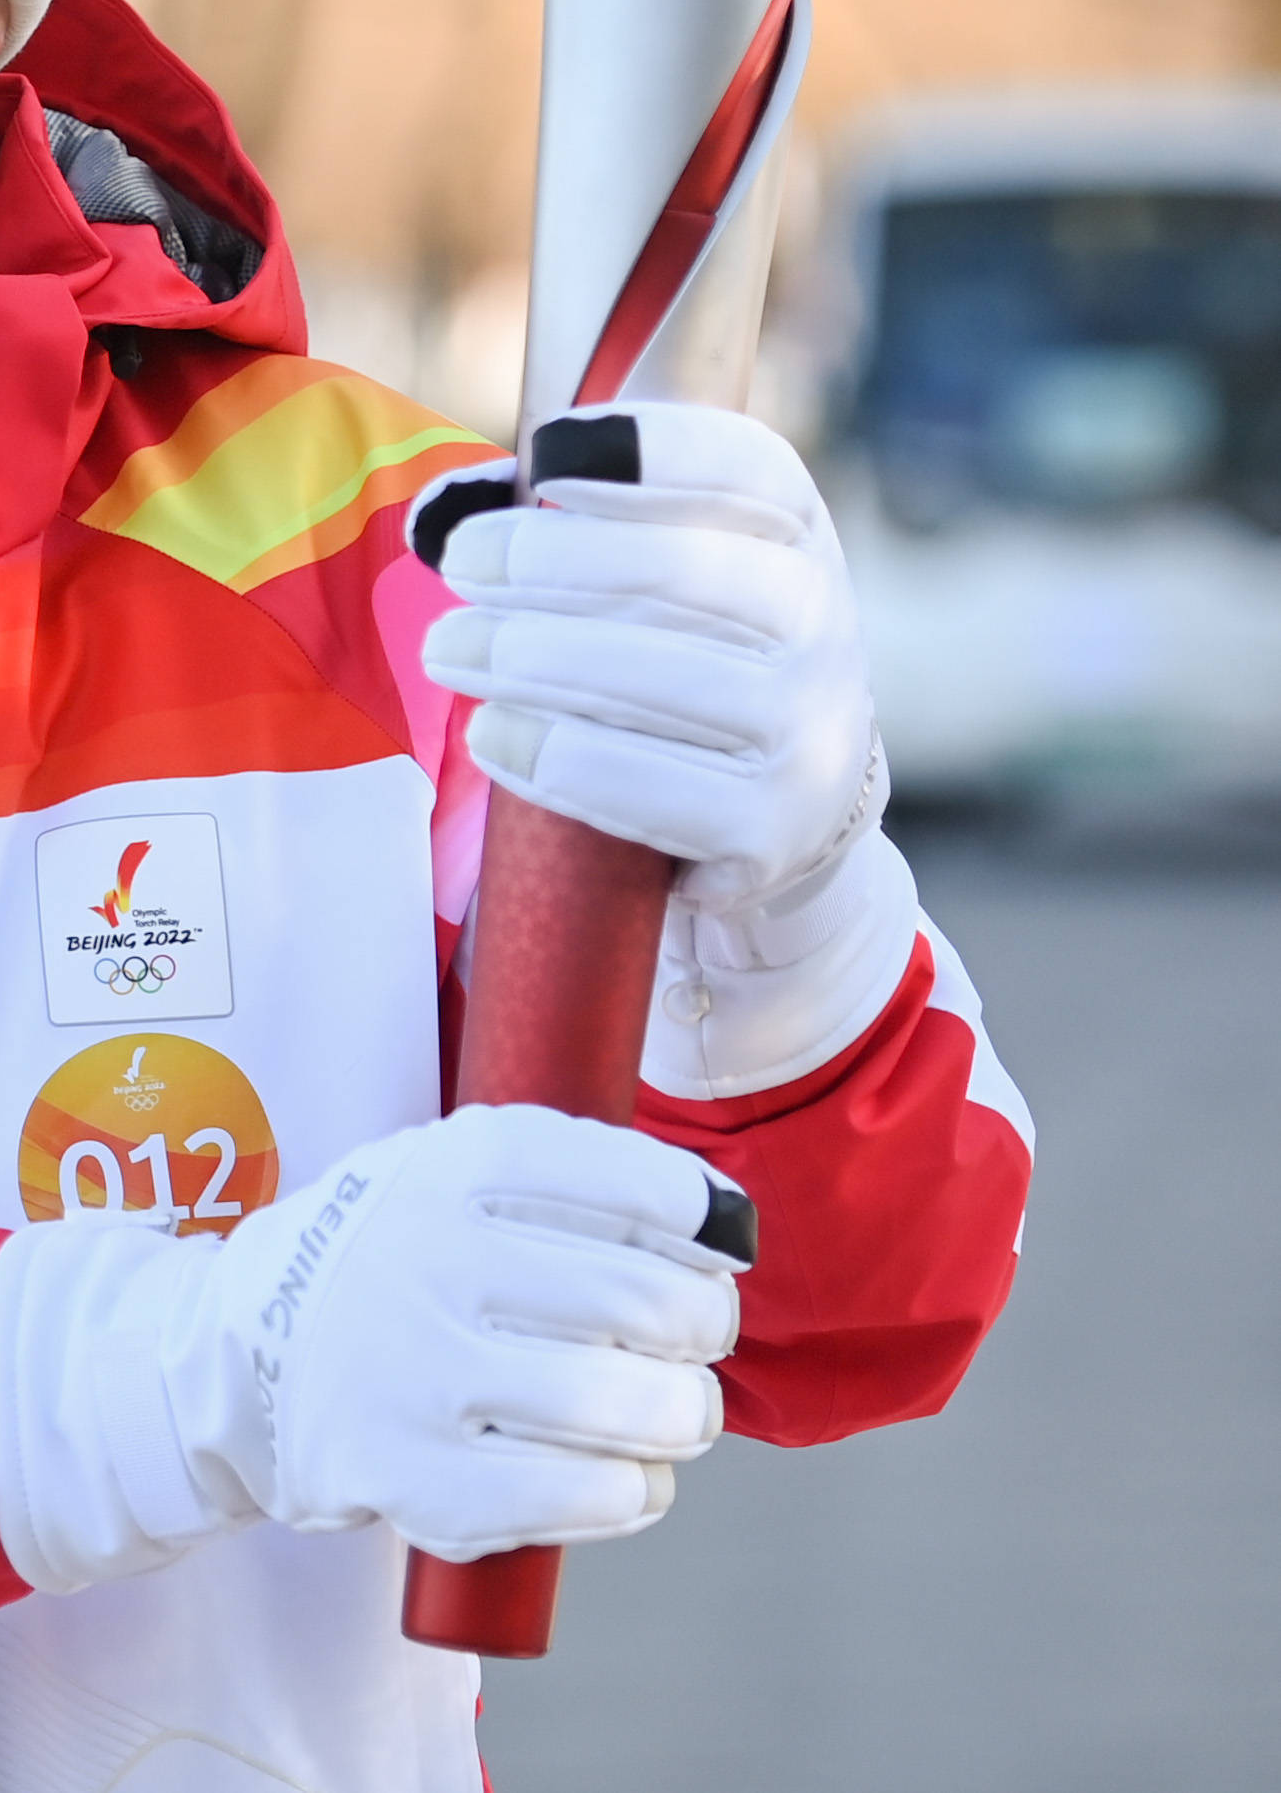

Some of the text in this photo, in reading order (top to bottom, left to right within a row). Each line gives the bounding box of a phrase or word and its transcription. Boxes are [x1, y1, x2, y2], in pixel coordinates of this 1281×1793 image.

[132, 907, 167, 919] Olympic
[134, 918, 180, 927] Torch Relay
[66, 932, 136, 955] BEIJING
[143, 929, 196, 946] 2022
[58, 1126, 243, 1220] 012
[261, 1172, 371, 1340] BEIJING
